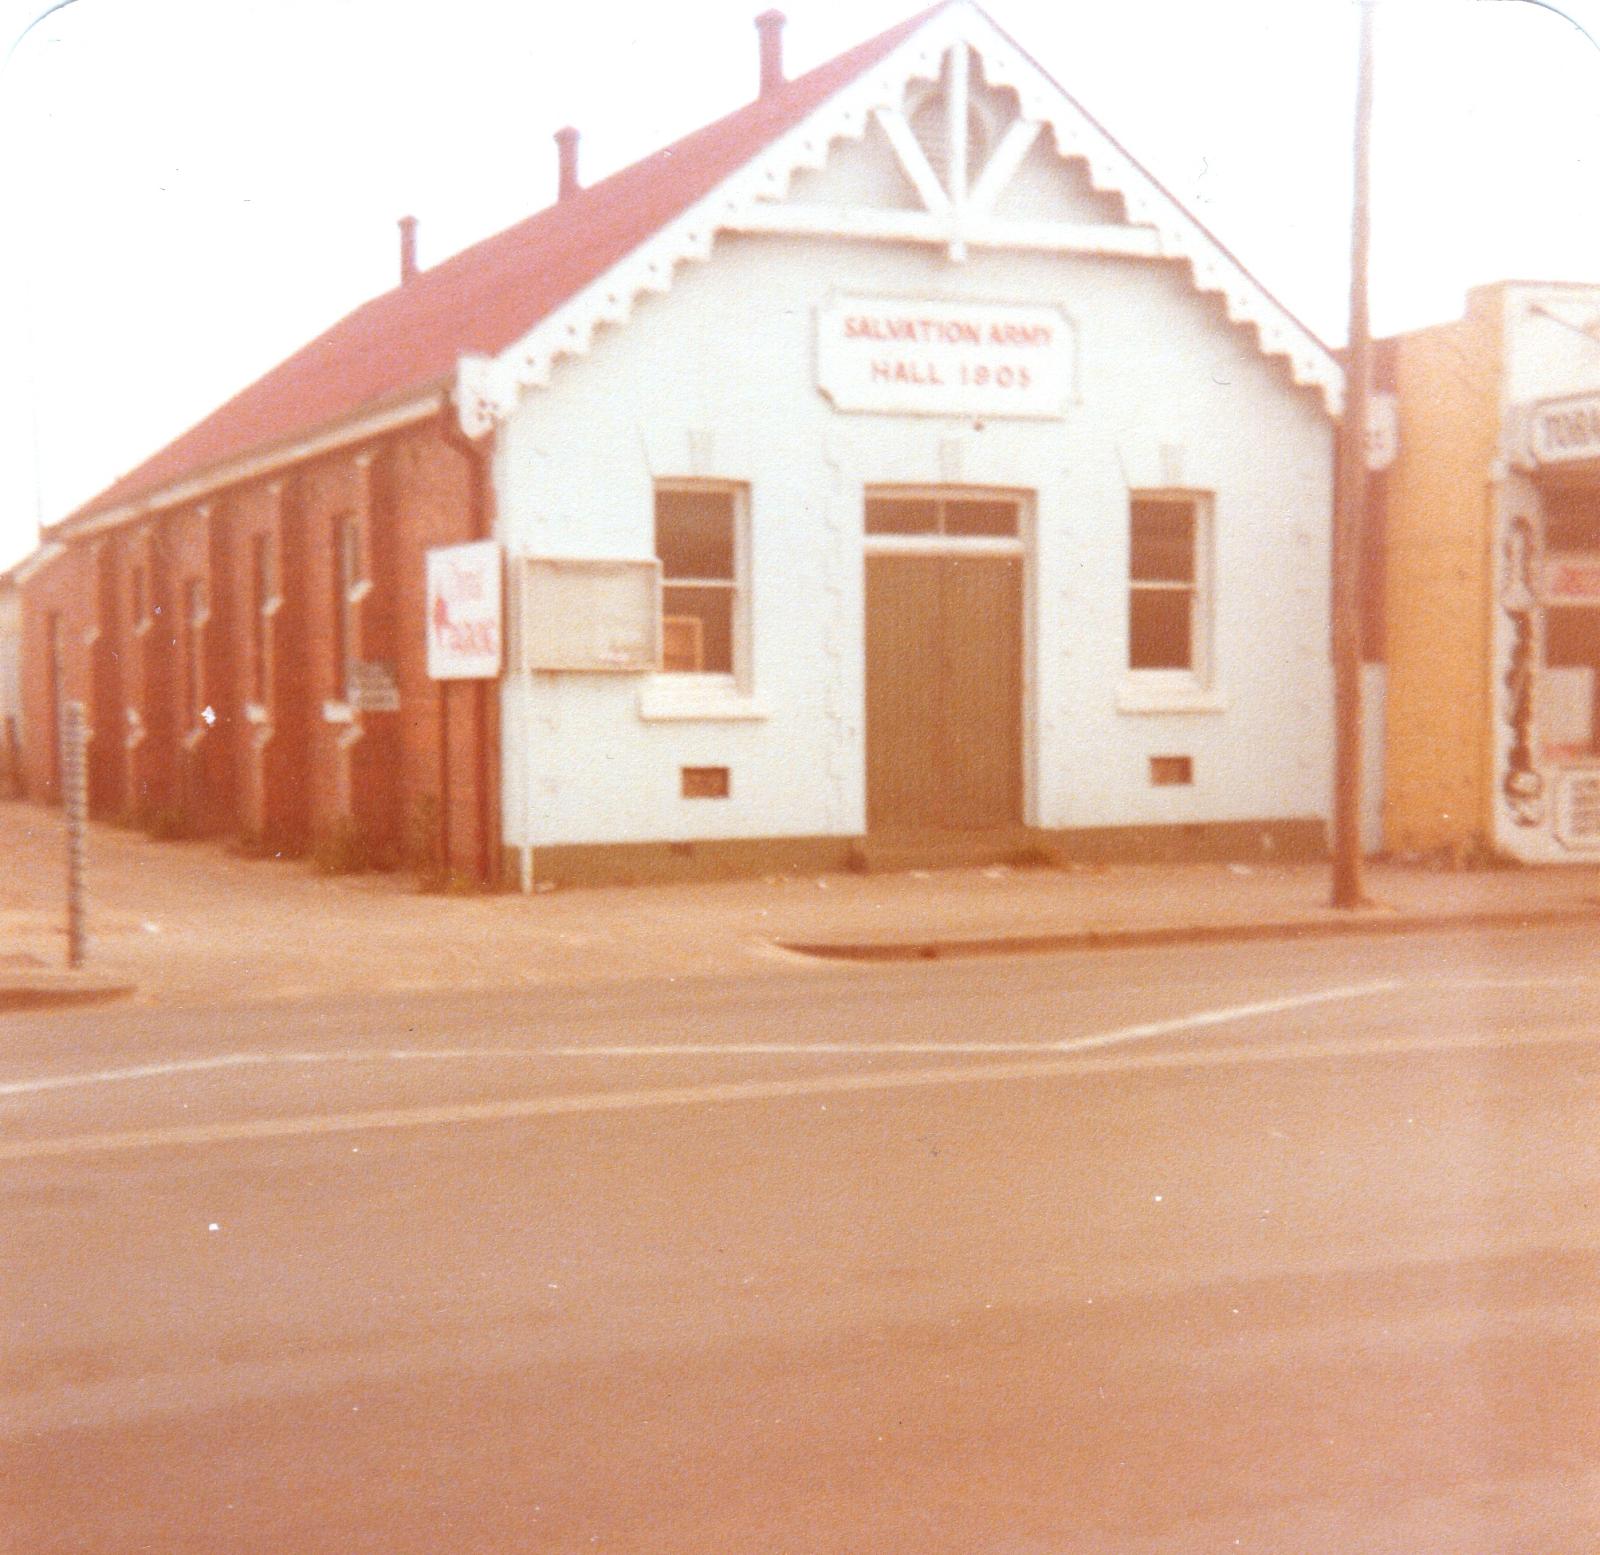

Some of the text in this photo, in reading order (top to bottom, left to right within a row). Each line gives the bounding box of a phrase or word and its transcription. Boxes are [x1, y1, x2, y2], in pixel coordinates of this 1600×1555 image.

[844, 317, 1052, 346] SALVATION ARMY
[871, 361, 943, 384] HALL
